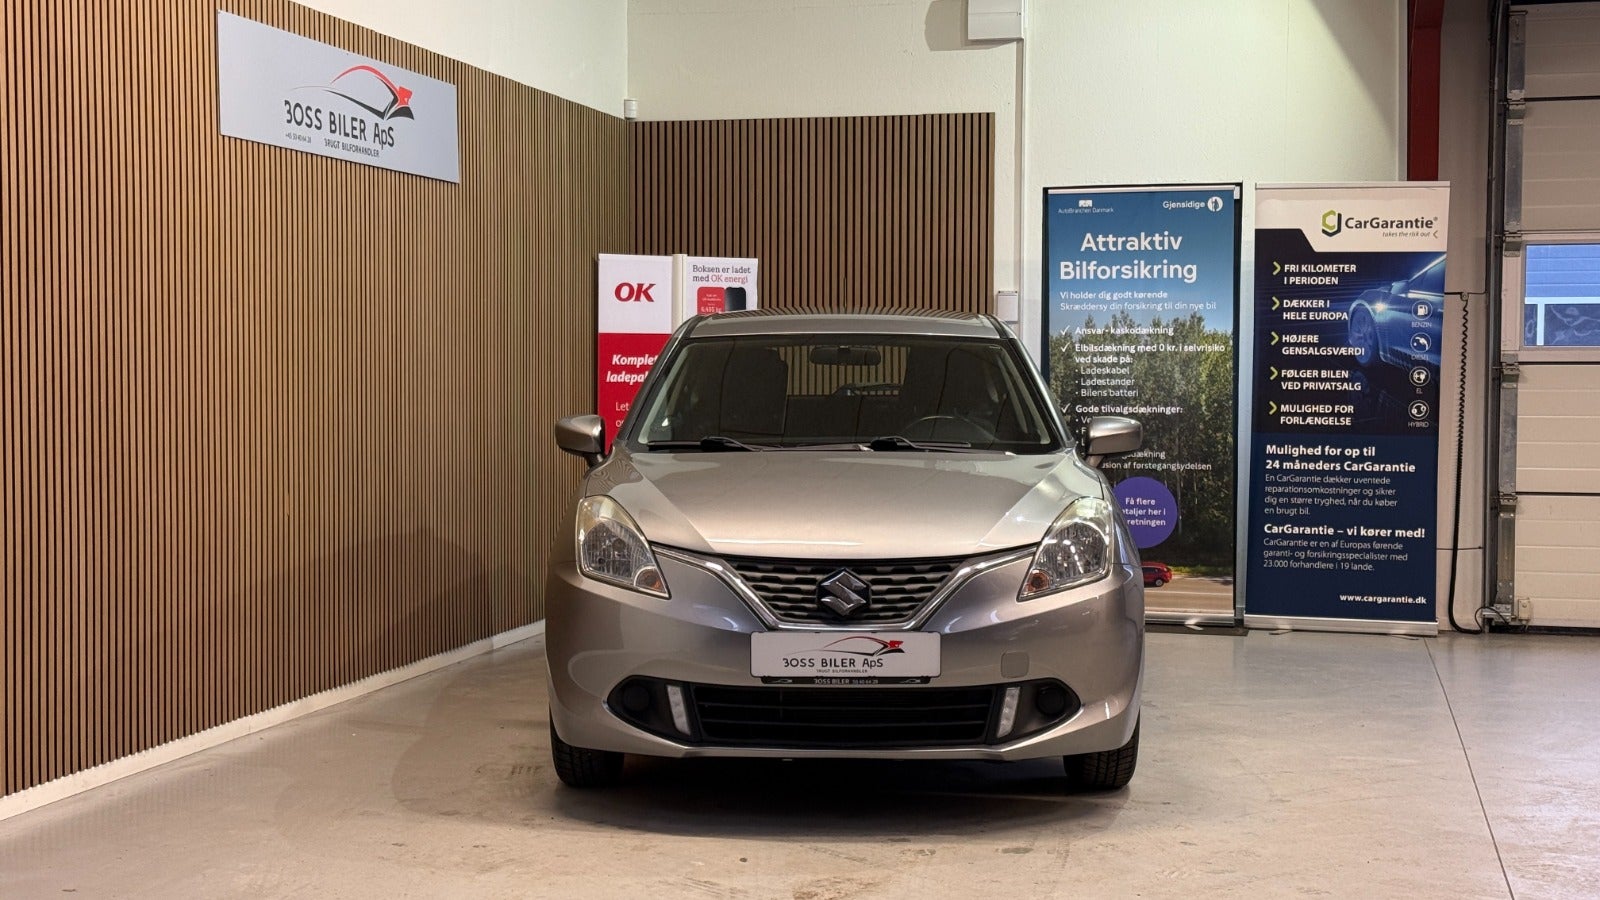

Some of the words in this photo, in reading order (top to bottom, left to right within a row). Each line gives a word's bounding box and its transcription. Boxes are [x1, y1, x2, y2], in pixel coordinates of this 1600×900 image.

[329, 111, 367, 141] BILER
[373, 122, 394, 150] ApS
[1163, 200, 1205, 209] Gjensidige
[1080, 231, 1183, 252] Attraktiv
[693, 264, 720, 273] Boksen
[732, 266, 751, 274] ladet
[1060, 259, 1197, 284] Bilforsikring
[1284, 264, 1299, 272] FRI
[1301, 264, 1357, 273] KILOMETER
[693, 274, 709, 282] med
[711, 274, 723, 282] OK
[724, 276, 748, 285] energi
[1289, 276, 1339, 285] PERIODEN
[614, 282, 656, 302] OK
[1060, 291, 1069, 299] Vi
[1070, 291, 1096, 299] holder
[1098, 291, 1111, 300] dig
[1113, 291, 1132, 300] godt
[1134, 290, 1168, 299] kørende
[1060, 302, 1107, 312] Skræddersy
[1110, 302, 1122, 310] din
[1124, 302, 1162, 311] forsikring
[1189, 303, 1203, 311] nye
[1206, 301, 1216, 309] bil
[1283, 299, 1325, 308] DÆKKER
[1283, 312, 1306, 320] HELE
[1309, 312, 1349, 320] EUROPA
[1075, 326, 1108, 335] Ansvar-
[1111, 326, 1174, 336] kaskodækning
[1282, 334, 1319, 343] HØJERE
[1075, 343, 1135, 354] Elbilsdækning
[1137, 343, 1157, 352] med
[1159, 344, 1164, 352] 0
[1166, 343, 1178, 352] kr.
[1183, 343, 1225, 352] selvrisiko
[1282, 347, 1365, 356] GENSALGSVÆRDI
[1075, 355, 1091, 363] ved
[1093, 355, 1118, 363] skade
[1120, 355, 1133, 365] på:
[1081, 367, 1130, 375] Ladeskabel
[1281, 369, 1319, 378] FØLGER
[1321, 370, 1349, 378] BILEN
[1081, 378, 1135, 386] Ladestander
[1281, 382, 1301, 390] VED
[1303, 382, 1362, 391] PRIVATSALG
[1081, 389, 1108, 397] Bilens
[1109, 388, 1139, 397] batteri
[615, 402, 629, 411] Let
[1075, 405, 1099, 414] Gode
[1101, 405, 1183, 415] tilvalgsdækninger:
[1280, 404, 1333, 413] MULIGHED
[1335, 405, 1354, 413] FOR
[1280, 417, 1352, 425] FORLÆNGELSE
[1266, 444, 1322, 458] Mulighed
[1324, 446, 1342, 456] for
[1344, 448, 1360, 458] op
[1363, 446, 1376, 457] til
[1123, 461, 1131, 469] af
[1133, 462, 1212, 471] førstegangsydelsen
[1265, 459, 1280, 469] 24
[1282, 459, 1341, 471] måneders
[1343, 461, 1416, 473] CarGarantie
[1265, 474, 1275, 482] En
[1276, 474, 1321, 483] CarGarantie
[1323, 475, 1352, 484] dækker
[1353, 476, 1391, 485] uventede
[1265, 485, 1361, 496] reparationsomkostninger
[1361, 488, 1373, 496] og
[1375, 487, 1396, 495] sikrer
[1125, 497, 1134, 505] Få
[1136, 497, 1156, 505] flere
[1264, 496, 1277, 505] dig
[1290, 497, 1313, 506] større
[1314, 497, 1347, 507] tryghed,
[1348, 497, 1361, 506] når
[1362, 497, 1373, 506] du
[1375, 498, 1398, 507] køber
[1148, 508, 1161, 516] her
[1276, 506, 1297, 516] brugt
[1299, 507, 1310, 515] bil.
[1127, 518, 1166, 527] retningen
[1264, 523, 1334, 535] CarGarantie
[1346, 526, 1357, 536] vi
[1360, 526, 1392, 538] kører
[1395, 528, 1425, 538] med!
[1263, 538, 1308, 547] CarGarantie
[1331, 540, 1339, 548] af
[1340, 540, 1370, 550] Europas
[1372, 541, 1403, 550] førende
[1263, 549, 1293, 559] garanti-
[1306, 550, 1388, 562] forsikringsspecialister
[1390, 552, 1408, 561] med
[1263, 560, 1288, 568] 23.000
[1289, 560, 1334, 570] forhandlere
[1340, 562, 1349, 570] 19
[1351, 562, 1374, 571] lande.
[1339, 594, 1427, 604] www.cargarantie.dk
[821, 658, 856, 668] BILER
[862, 658, 883, 669] ApS
